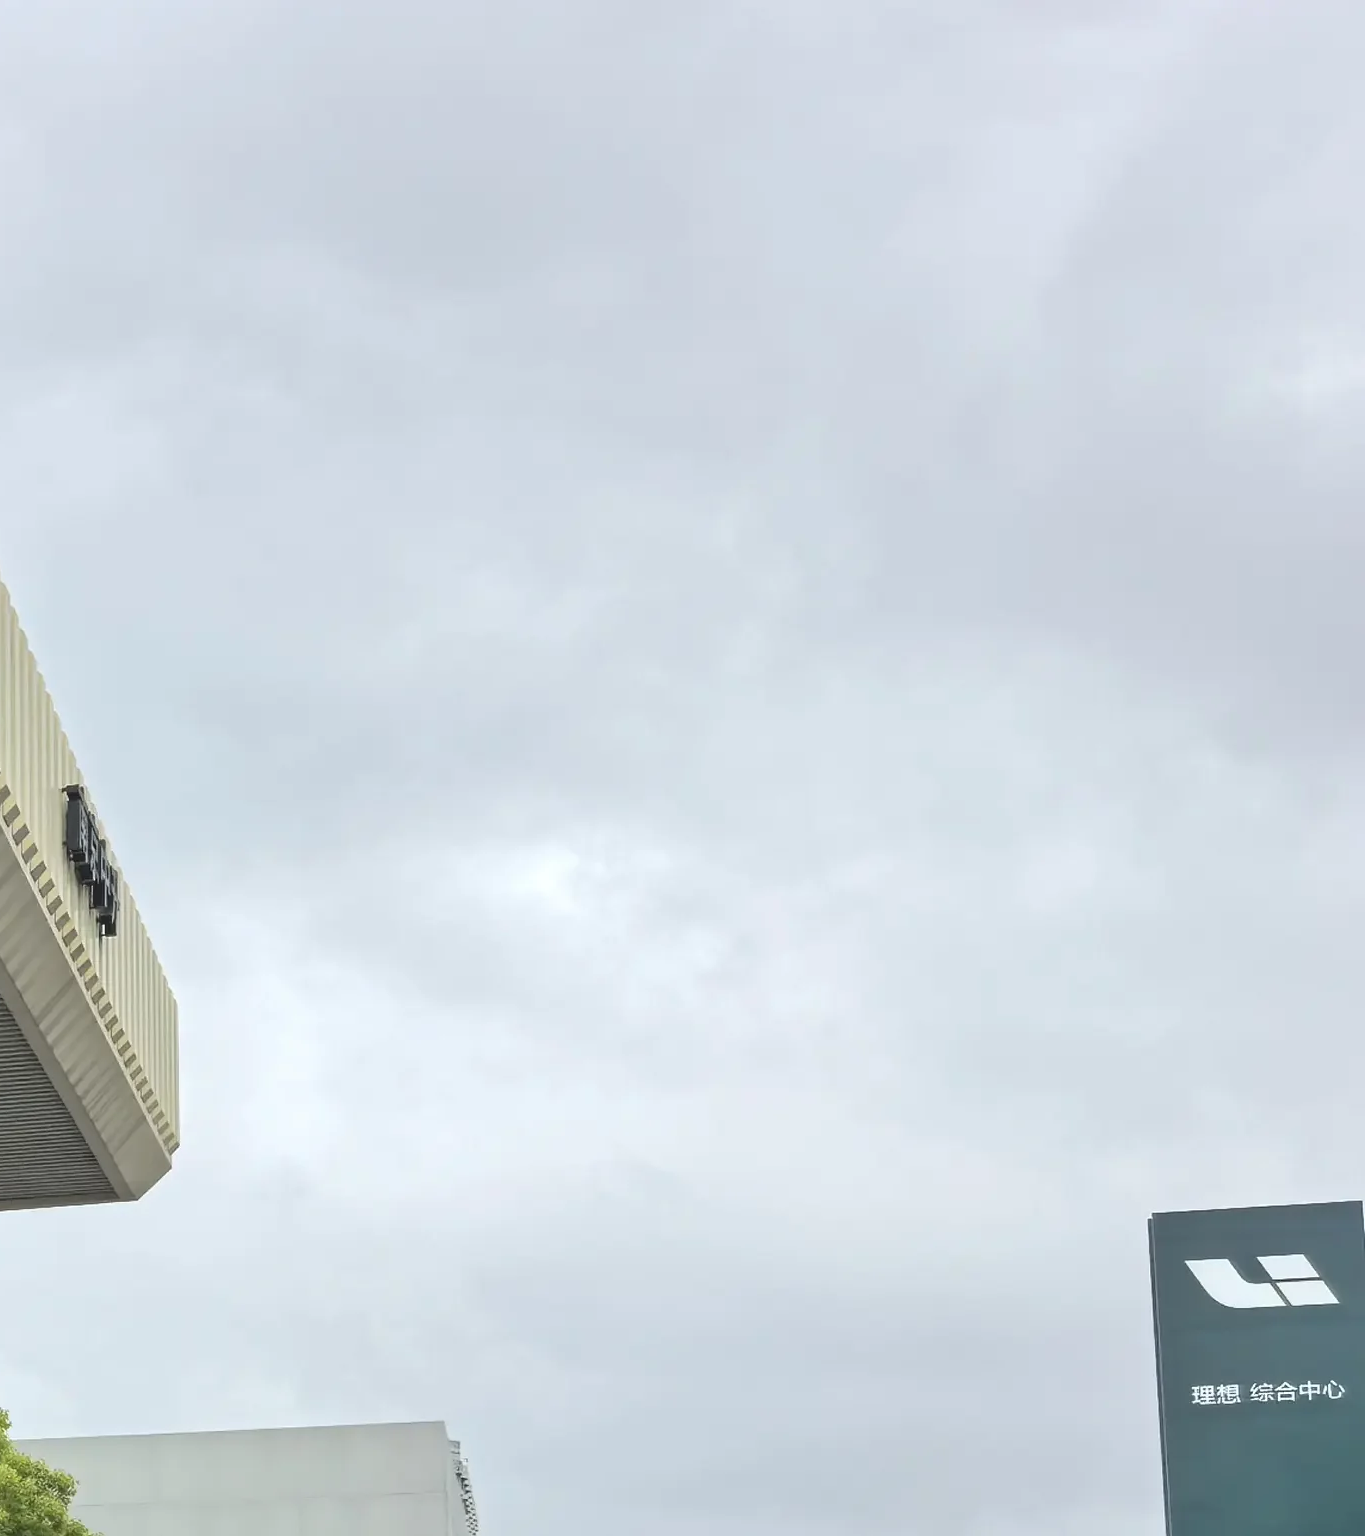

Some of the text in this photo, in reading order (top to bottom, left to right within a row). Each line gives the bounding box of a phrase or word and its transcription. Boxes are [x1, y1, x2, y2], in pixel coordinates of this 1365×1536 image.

[1191, 1380, 1346, 1405] 理想 综合中心
